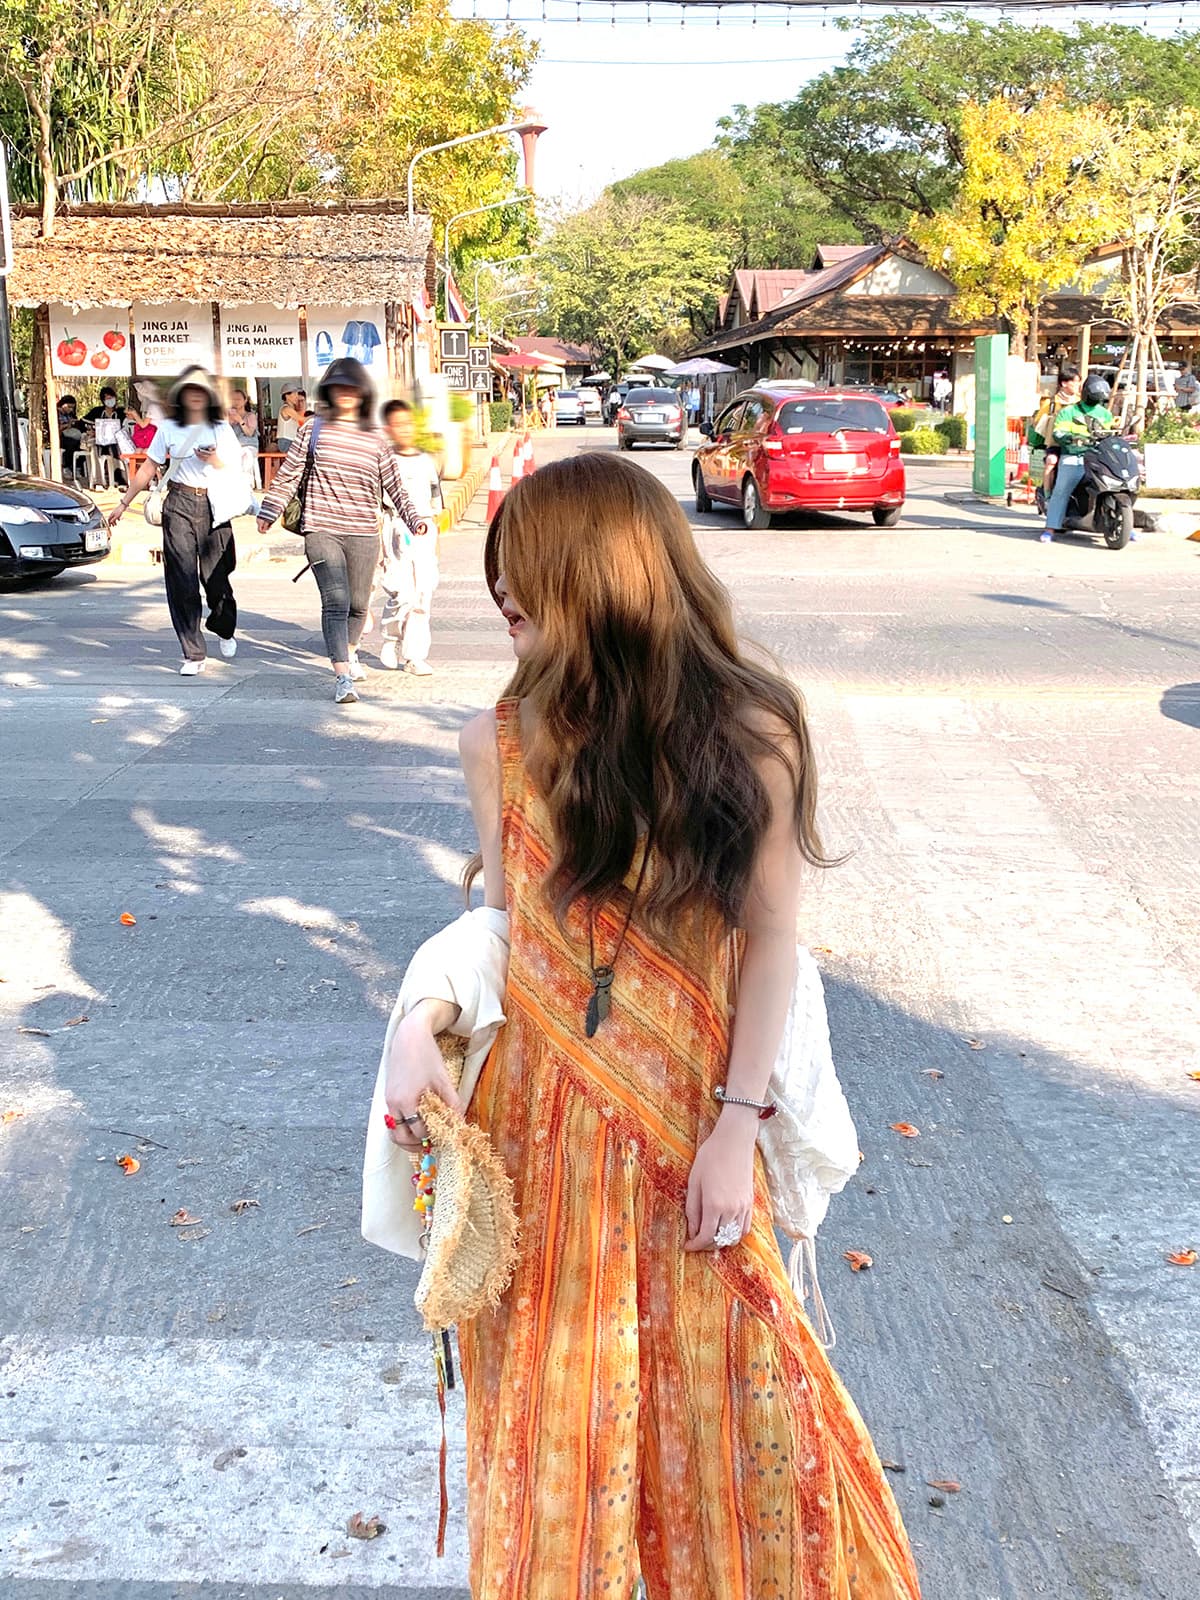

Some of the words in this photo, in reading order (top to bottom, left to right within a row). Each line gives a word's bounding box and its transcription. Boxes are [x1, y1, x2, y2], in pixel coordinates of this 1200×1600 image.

[142, 321, 168, 331] JING
[170, 321, 188, 330] JAI
[226, 324, 250, 333] JING
[252, 324, 267, 333] JAI
[142, 334, 190, 343] MARKET
[226, 337, 251, 345] FLEA
[253, 337, 295, 346] MARKET
[143, 346, 175, 356] OPEN
[228, 349, 256, 358] OPEN
[229, 361, 247, 369] AT
[256, 361, 278, 370] SUN
[447, 367, 464, 376] ONE
[448, 377, 464, 386] WAY
